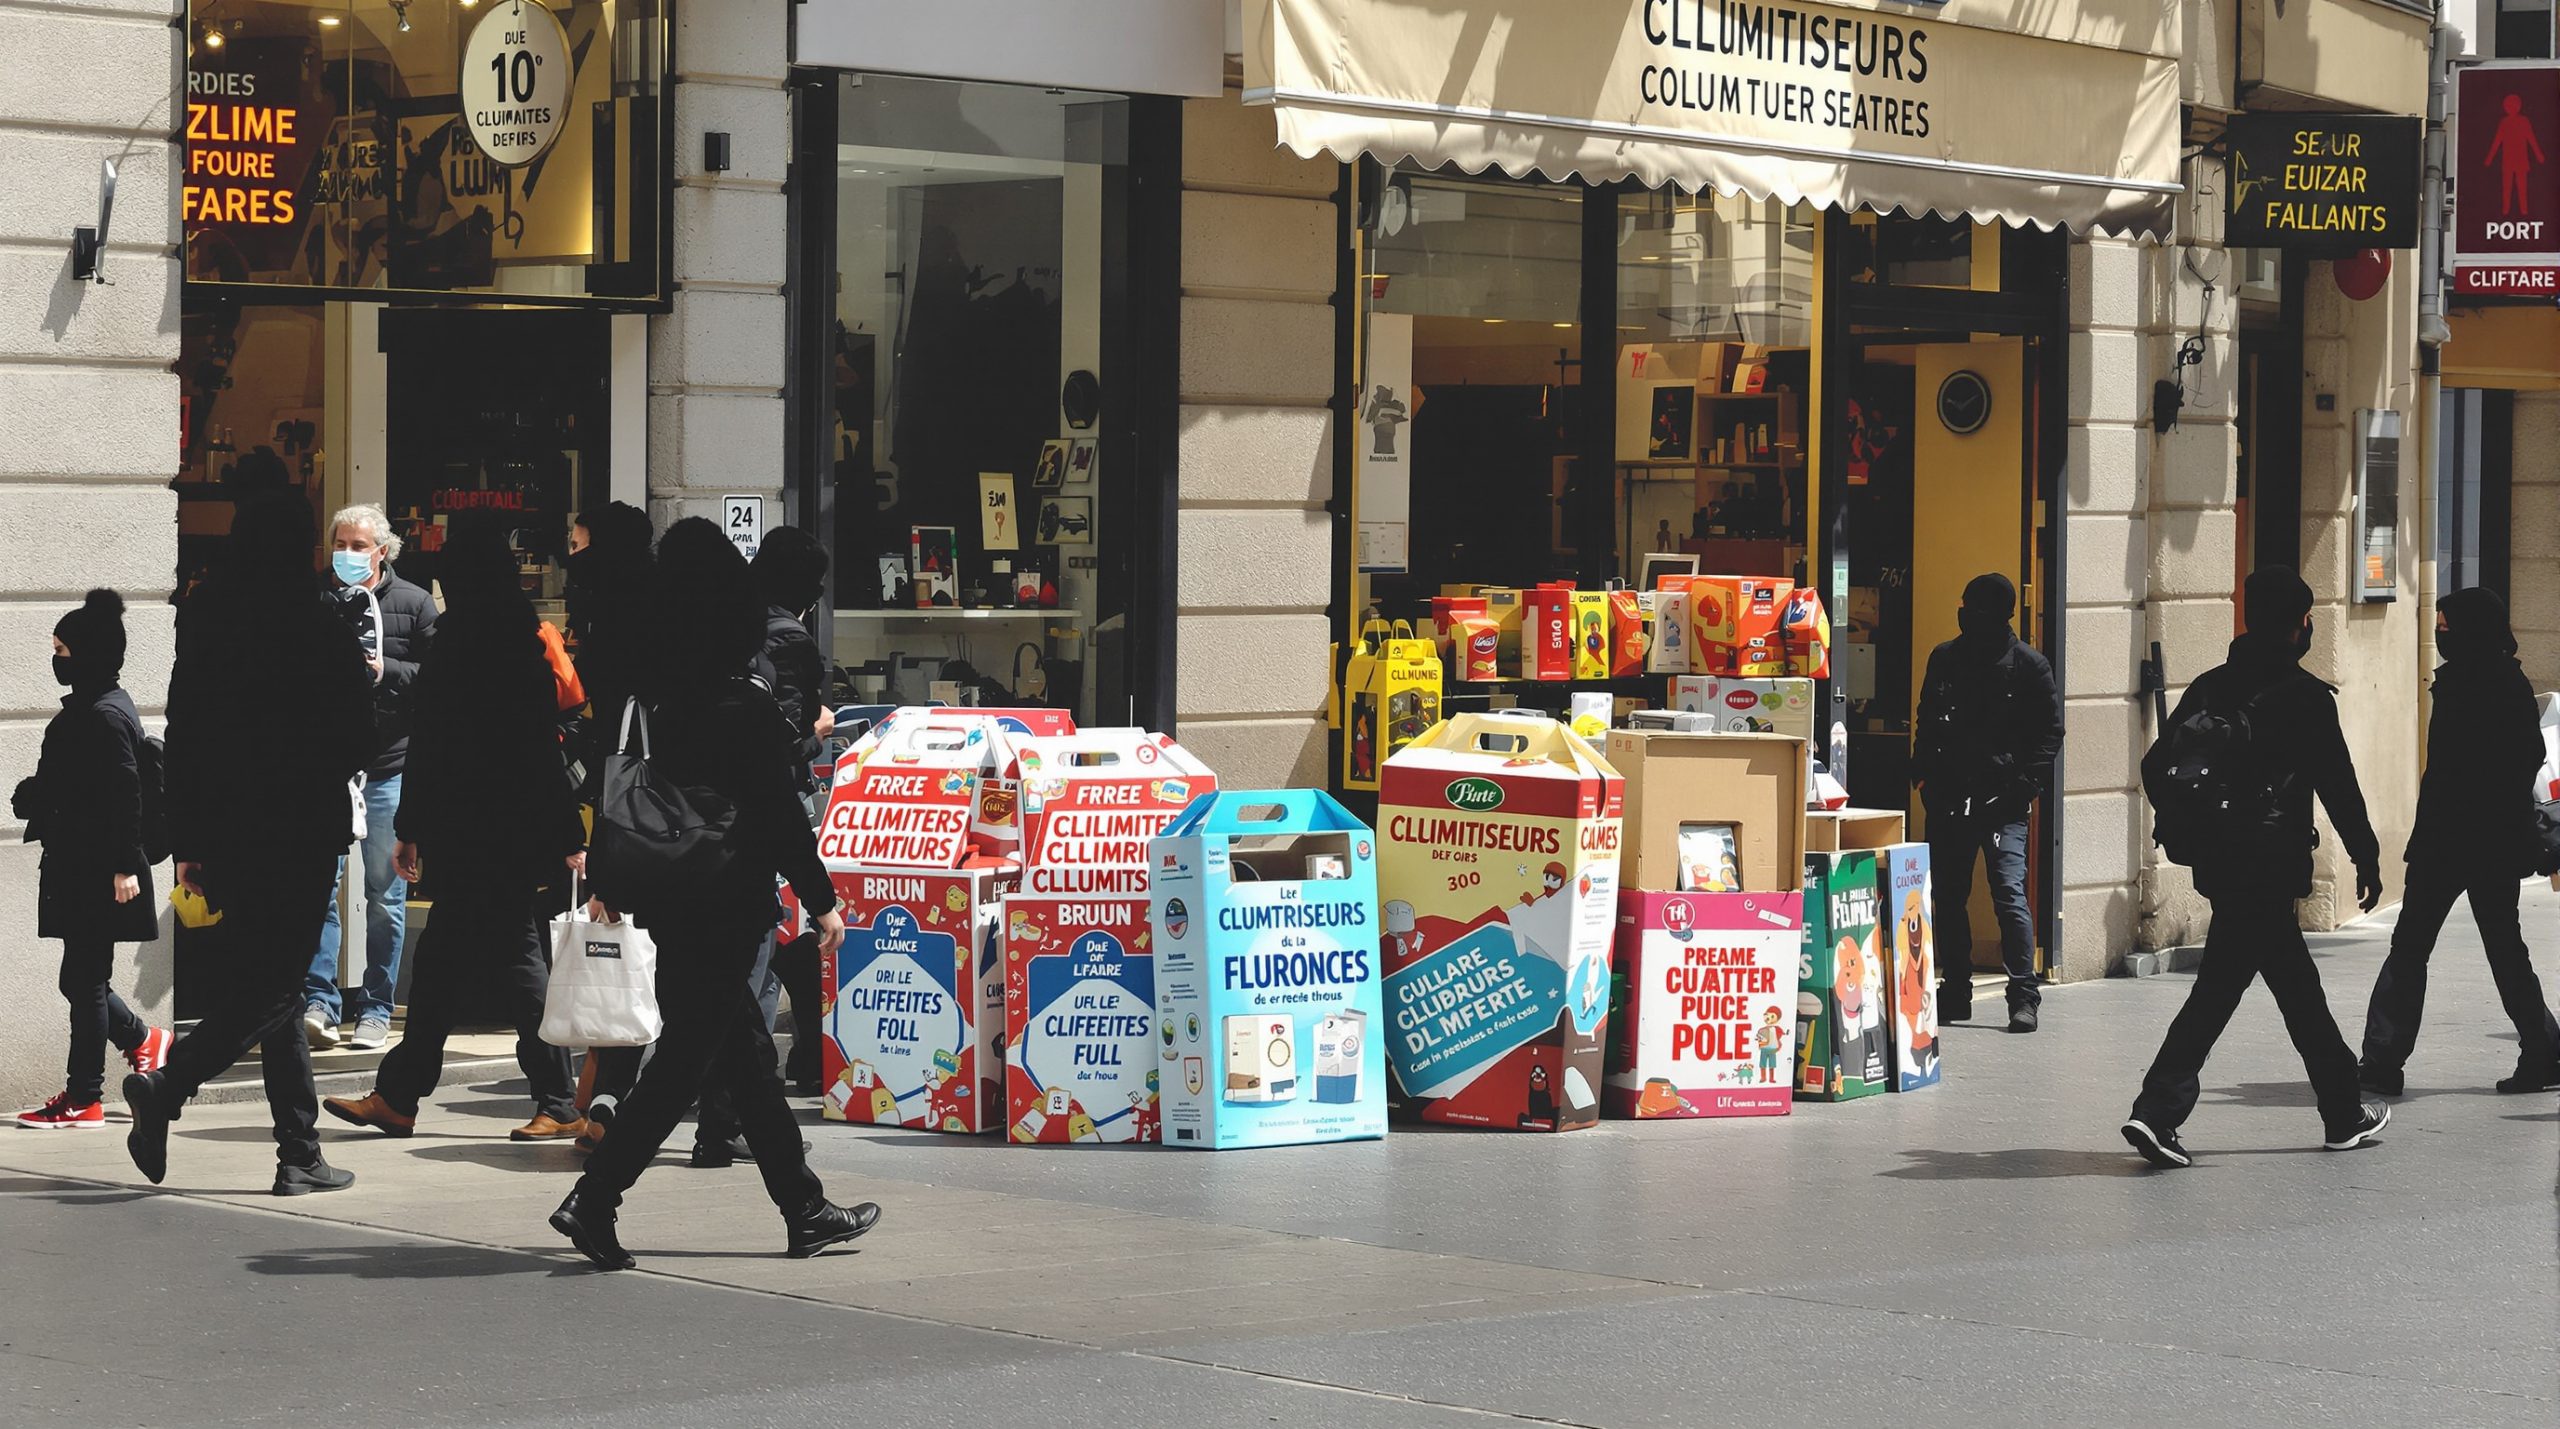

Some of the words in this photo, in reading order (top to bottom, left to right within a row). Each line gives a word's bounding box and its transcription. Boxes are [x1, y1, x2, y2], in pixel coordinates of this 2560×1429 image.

[505, 31, 526, 44] DUE
[187, 104, 296, 144] ZLIME
[1823, 88, 1930, 138] SEATRES
[193, 150, 275, 178] FOURE
[2285, 165, 2367, 193] EUIZAR
[183, 187, 295, 224] FARES
[2265, 202, 2386, 232] FALLANTS
[2486, 222, 2544, 240] PORT
[2469, 271, 2555, 288] CLIFTARE
[731, 506, 753, 527] 24
[1076, 785, 1142, 805] FRREE
[1447, 871, 1481, 891] 300
[1224, 949, 1370, 990] FLURONCES
[1684, 948, 1756, 965] PREAME
[1399, 947, 1488, 1004] CULLARE
[1405, 1027, 1443, 1055] DL
[1439, 977, 1533, 1037] MFERTE
[1681, 996, 1749, 1020] PUICE
[877, 1018, 919, 1042] FOLL
[1672, 1023, 1752, 1061] POLE
[1074, 1044, 1121, 1066] FULL
